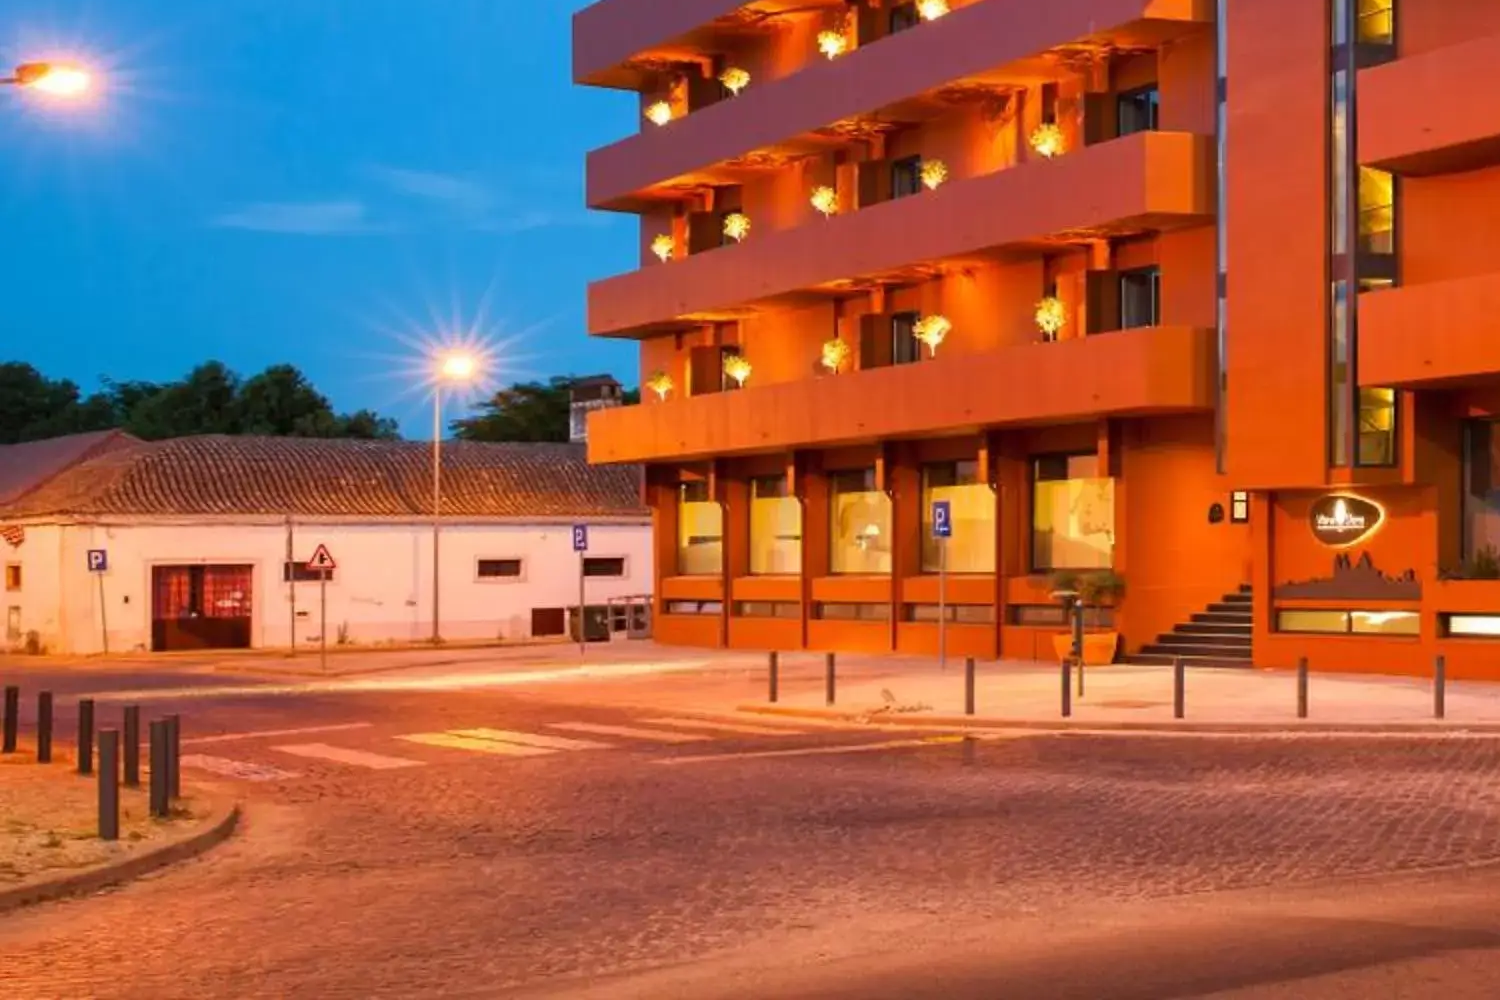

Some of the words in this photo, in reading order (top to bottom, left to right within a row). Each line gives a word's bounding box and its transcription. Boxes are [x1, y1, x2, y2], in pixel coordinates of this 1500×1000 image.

[935, 508, 945, 531] P
[575, 528, 583, 546] P
[90, 551, 103, 569] P
